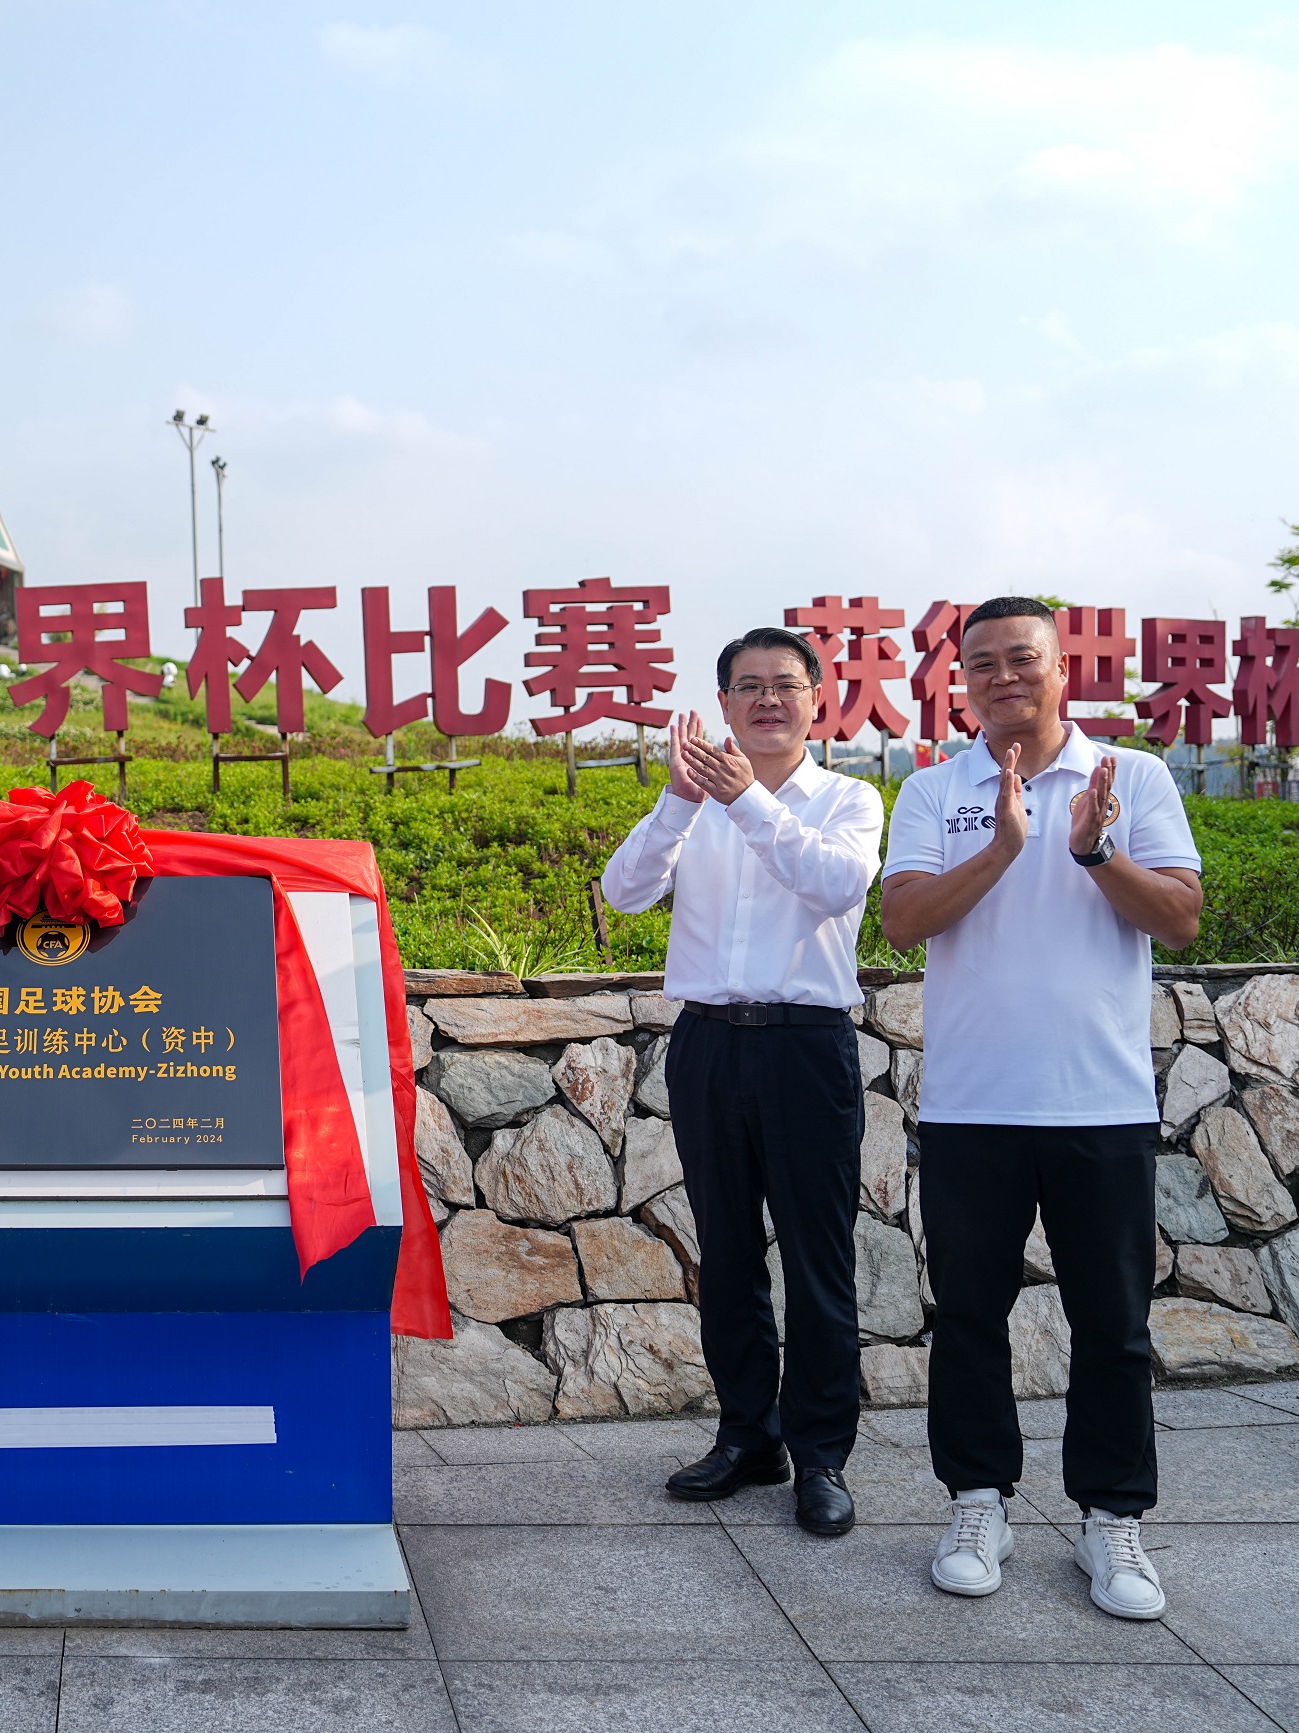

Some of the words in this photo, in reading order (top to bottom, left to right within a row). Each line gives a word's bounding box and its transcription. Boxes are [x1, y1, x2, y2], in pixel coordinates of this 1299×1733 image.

[43, 941, 63, 949] CFA
[57, 1061, 237, 1082] Academy-Zizhong
[131, 1134, 190, 1145] February
[196, 1134, 223, 1143] 2024
